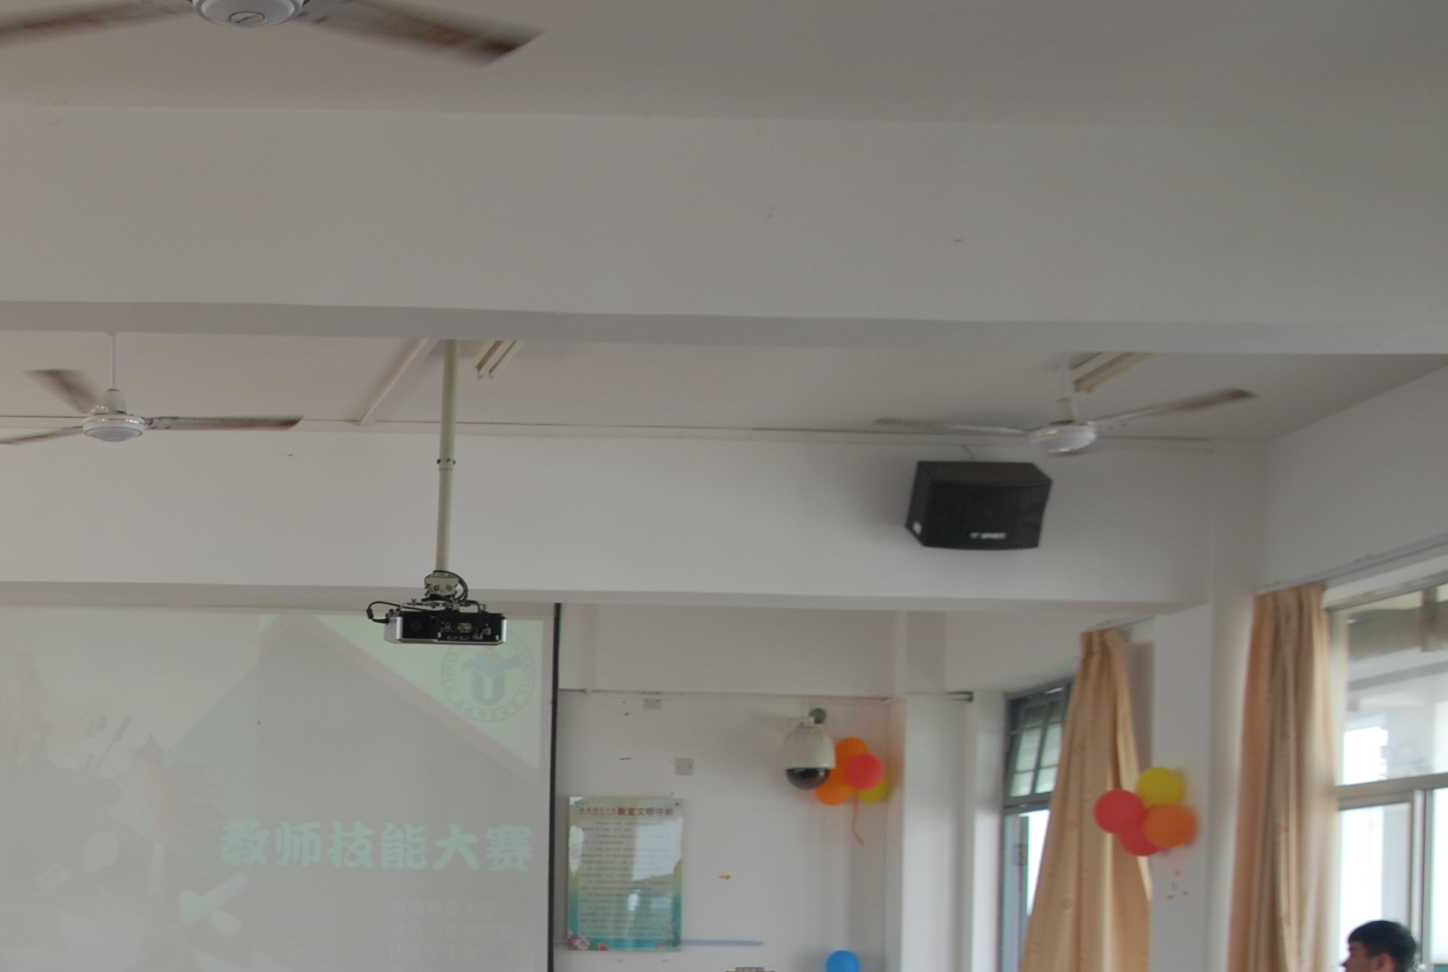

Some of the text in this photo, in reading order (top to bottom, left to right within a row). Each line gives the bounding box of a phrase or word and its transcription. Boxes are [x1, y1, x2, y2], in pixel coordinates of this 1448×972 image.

[221, 818, 533, 873] 教师技能大赛
